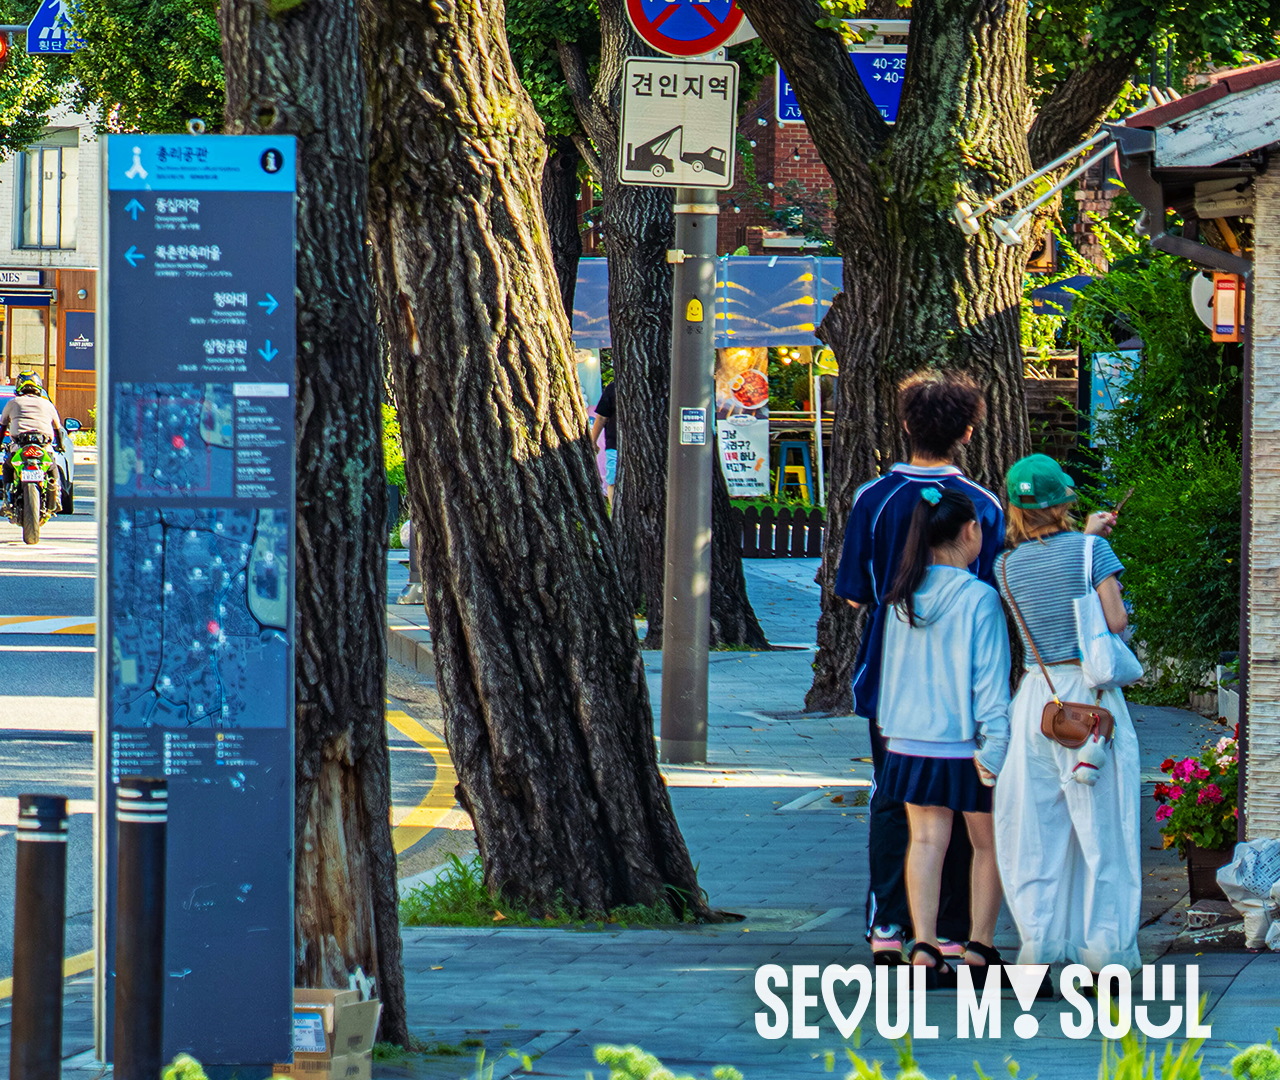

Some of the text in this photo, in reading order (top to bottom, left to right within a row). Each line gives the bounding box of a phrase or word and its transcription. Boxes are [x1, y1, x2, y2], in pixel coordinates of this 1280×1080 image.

[632, 73, 728, 100] 견인지역
[156, 146, 209, 163] 총리공관
[154, 244, 222, 261] 북촌한옥마을
[213, 292, 248, 308] 청와대
[203, 339, 248, 355] 삼청공원
